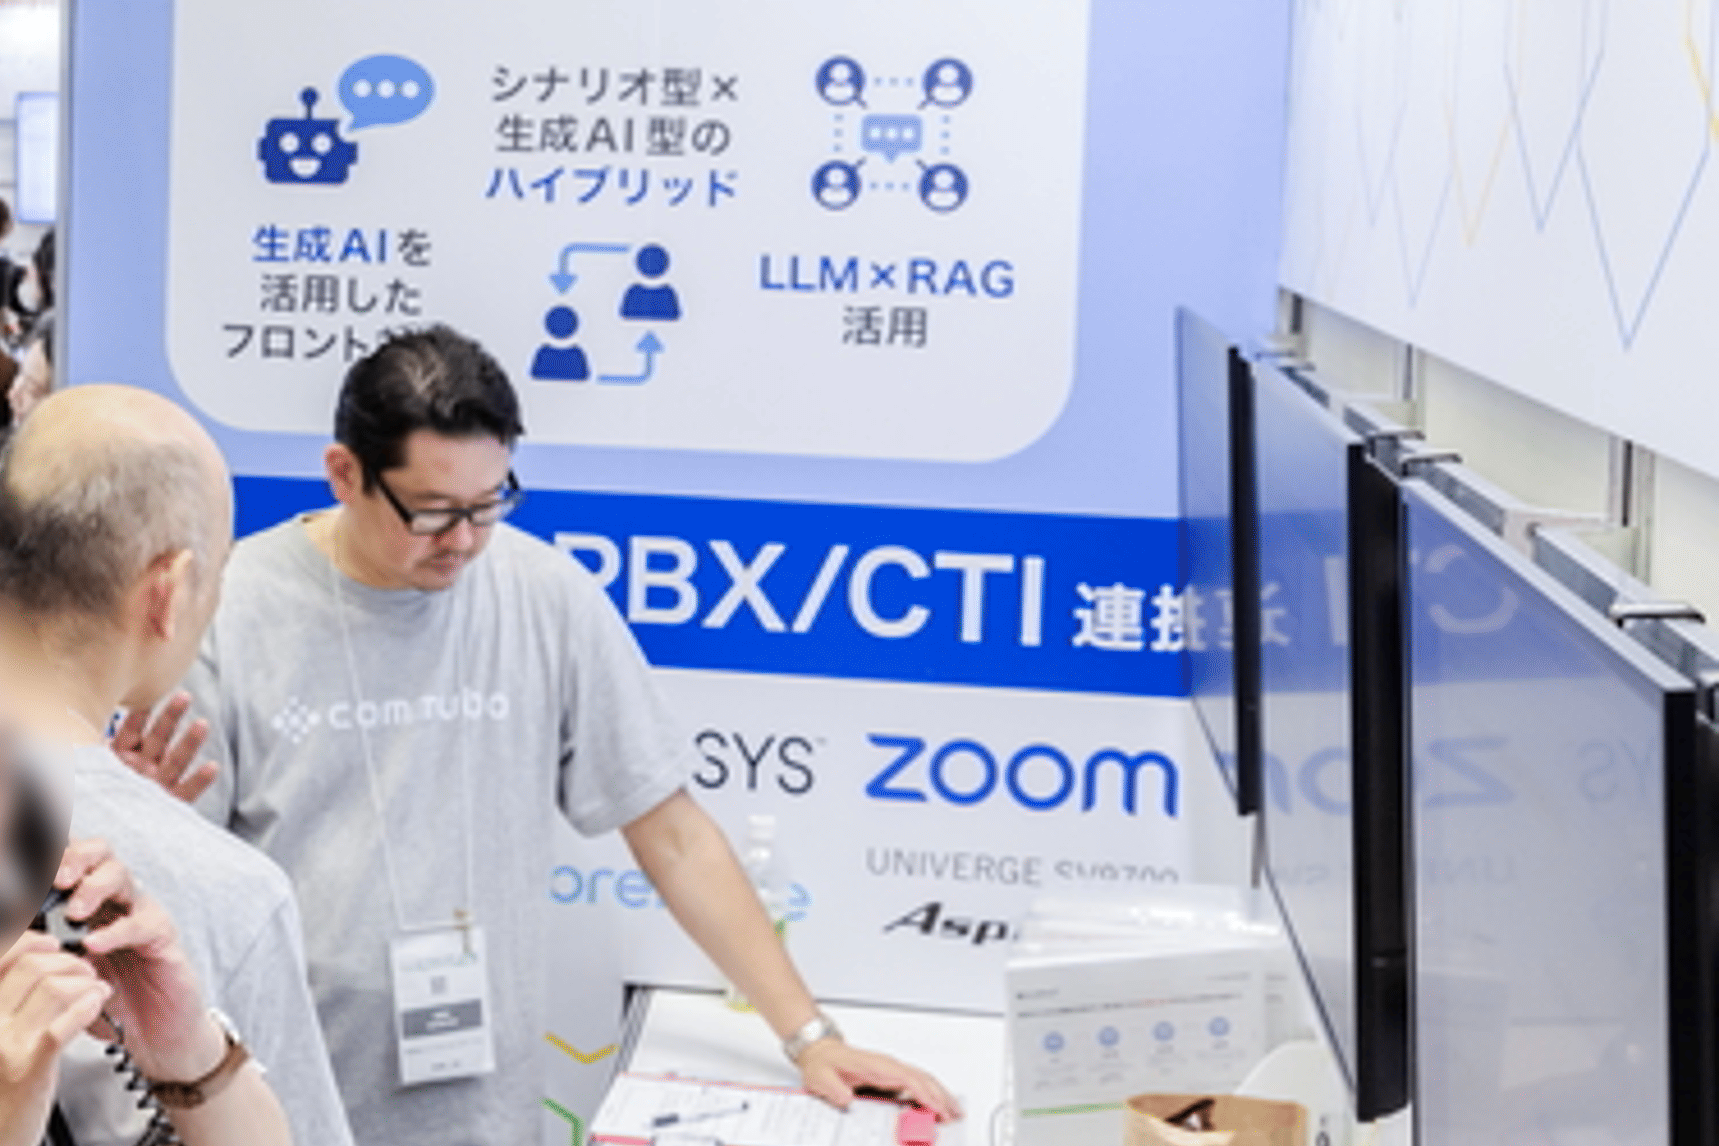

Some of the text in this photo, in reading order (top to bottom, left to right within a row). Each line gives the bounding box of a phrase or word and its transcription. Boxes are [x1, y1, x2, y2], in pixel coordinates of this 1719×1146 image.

[492, 66, 739, 106] シナリオ型×
[494, 114, 732, 157] 生成AI型の
[484, 165, 739, 207] ハイブリッド
[250, 224, 432, 267] 生成AIを
[259, 273, 423, 317] 活用した
[222, 321, 421, 363] フロント
[841, 303, 928, 349] 活用
[864, 731, 1180, 819] zoom
[864, 847, 1044, 887] UNIVERGE
[882, 900, 1021, 946] Asp
